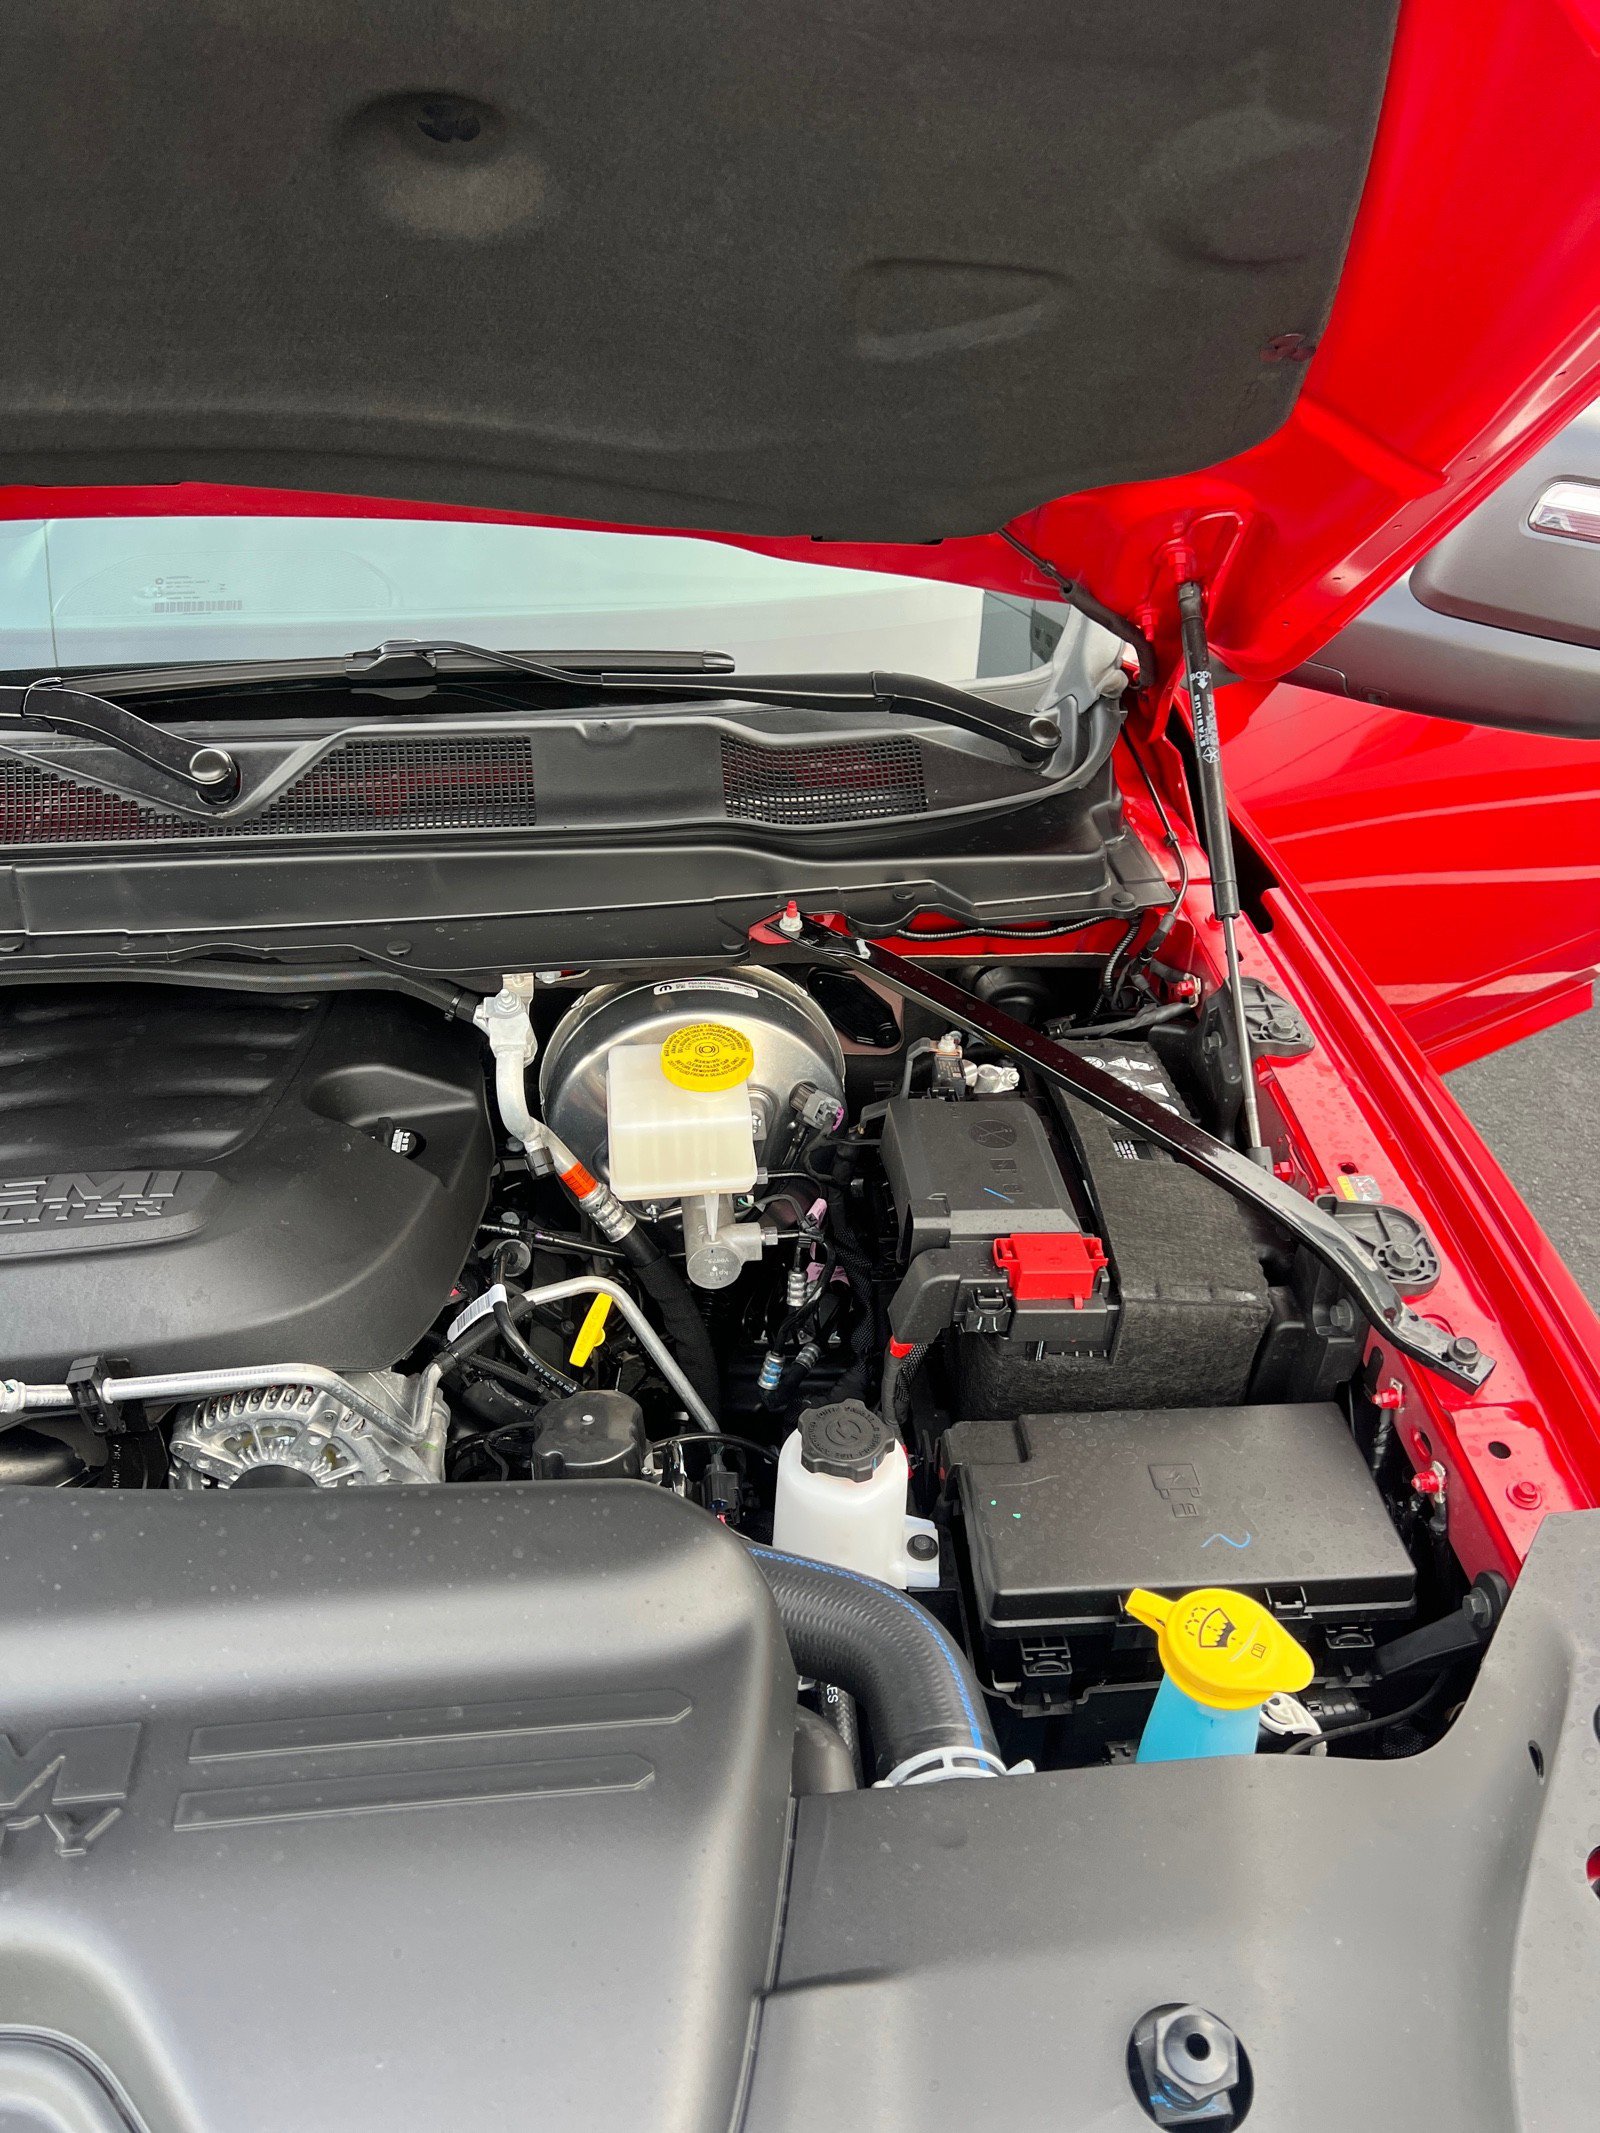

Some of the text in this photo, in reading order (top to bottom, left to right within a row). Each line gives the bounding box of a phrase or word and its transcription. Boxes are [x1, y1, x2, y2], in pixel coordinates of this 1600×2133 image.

[1190, 671, 1212, 681] BODY
[1194, 694, 1206, 747] STABILUS
[826, 1684, 839, 1703] ES
